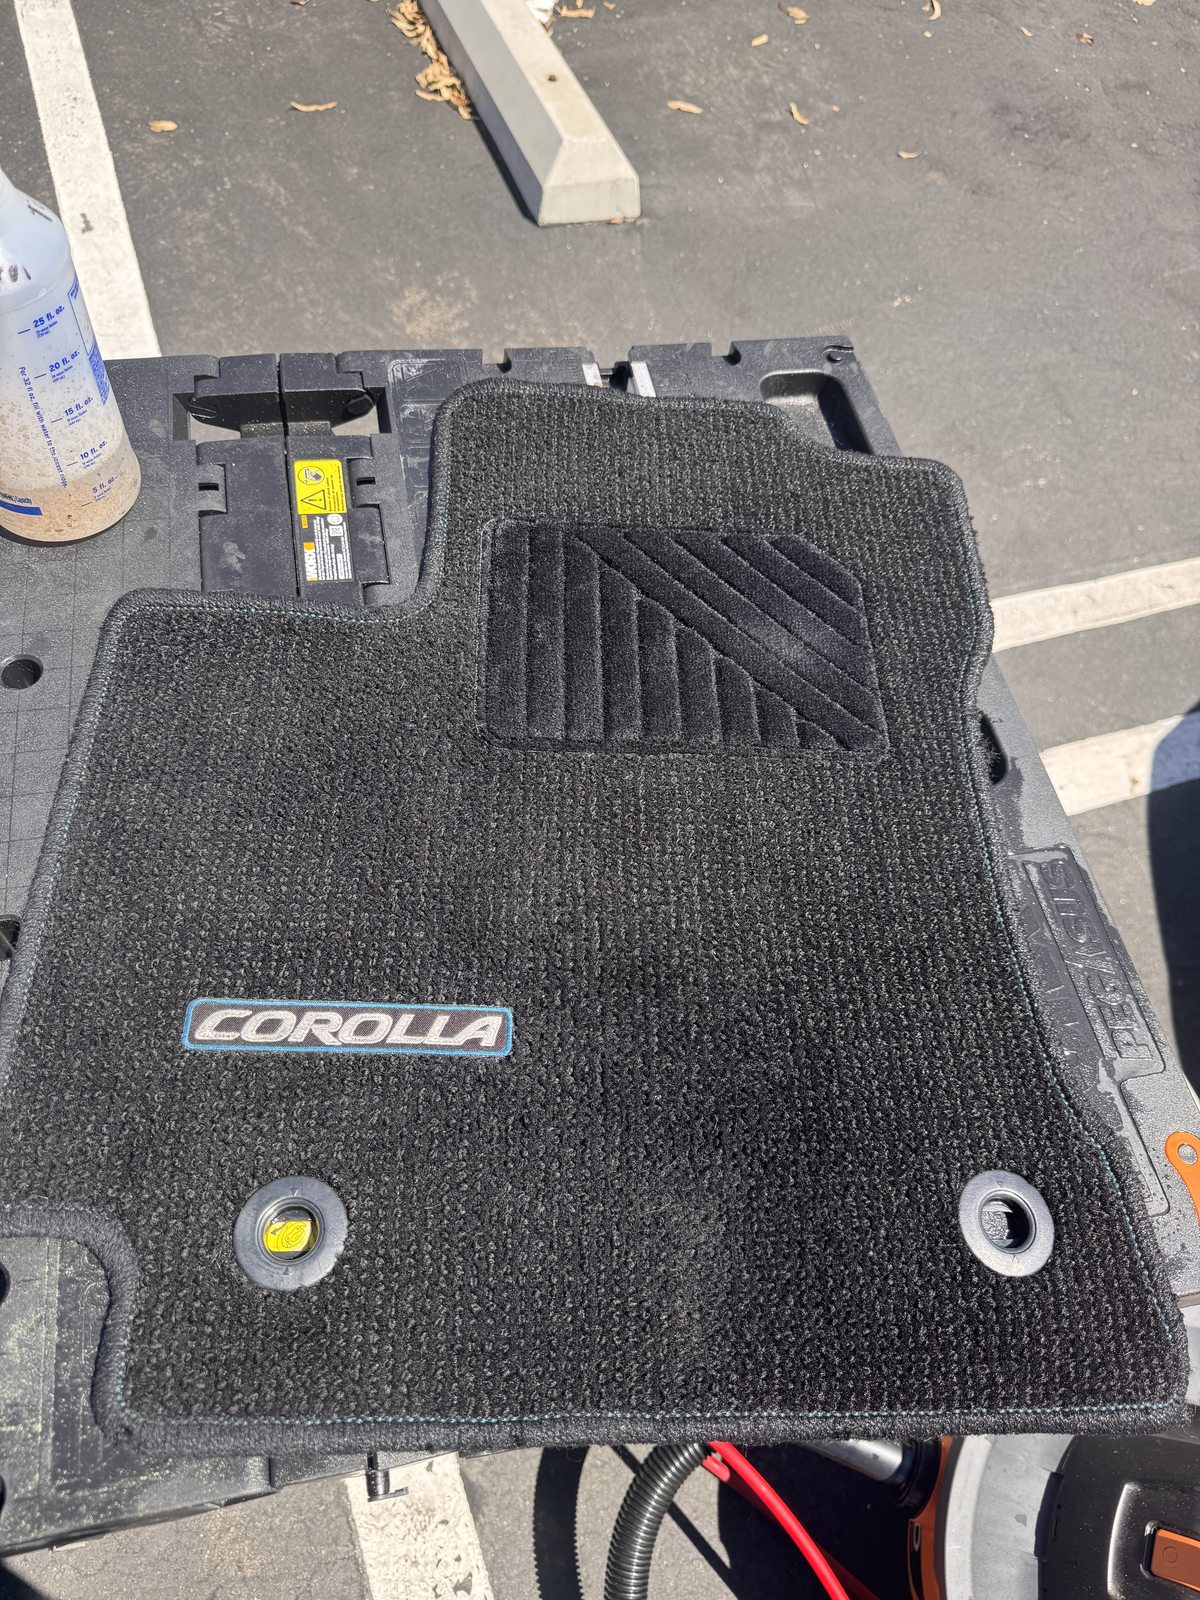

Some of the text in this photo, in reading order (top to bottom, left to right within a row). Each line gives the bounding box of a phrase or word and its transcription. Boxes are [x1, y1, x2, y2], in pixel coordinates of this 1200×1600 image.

[33, 305, 65, 328] 25 fl. oz.
[49, 350, 80, 372] 20 fl. oz.
[19, 366, 27, 377] For
[23, 377, 31, 386] 32
[35, 410, 44, 423] with
[41, 421, 51, 440] water
[64, 396, 93, 417] 15 fl. oz.
[80, 440, 108, 460] 10 fl. oz.
[107, 476, 117, 485] oz.
[304, 549, 318, 580] WORX
[194, 1009, 502, 1046] COROLLA
